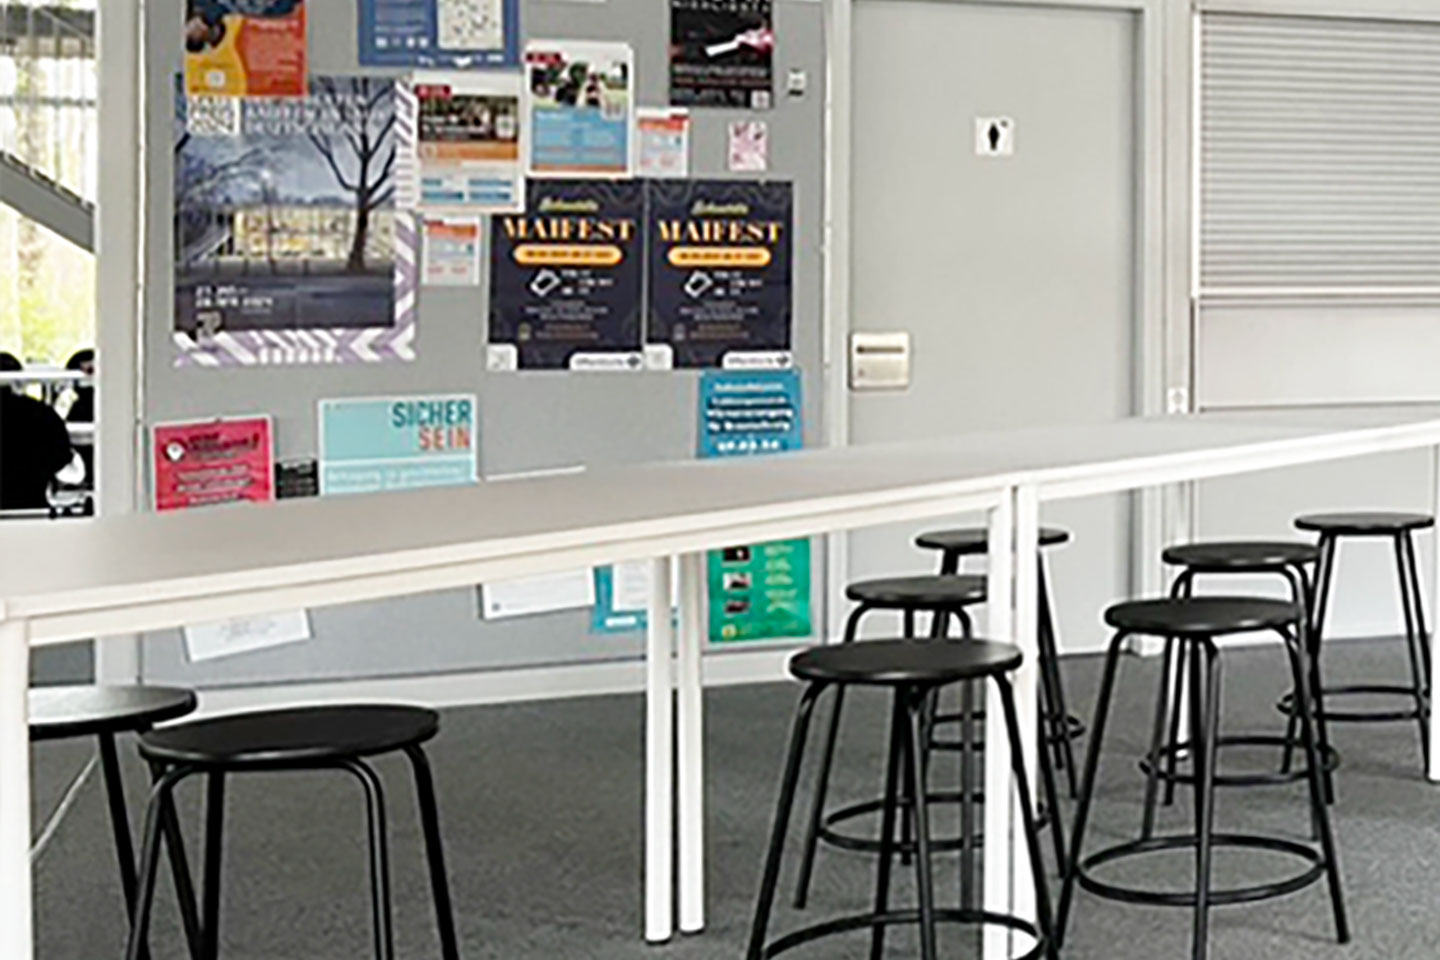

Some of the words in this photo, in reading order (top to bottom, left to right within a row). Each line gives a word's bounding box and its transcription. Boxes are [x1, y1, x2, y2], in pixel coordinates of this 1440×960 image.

[503, 217, 635, 240] MAIFEST
[659, 219, 782, 242] MAIFEST
[392, 400, 471, 428] SICHER
[419, 426, 471, 450] SEIN
